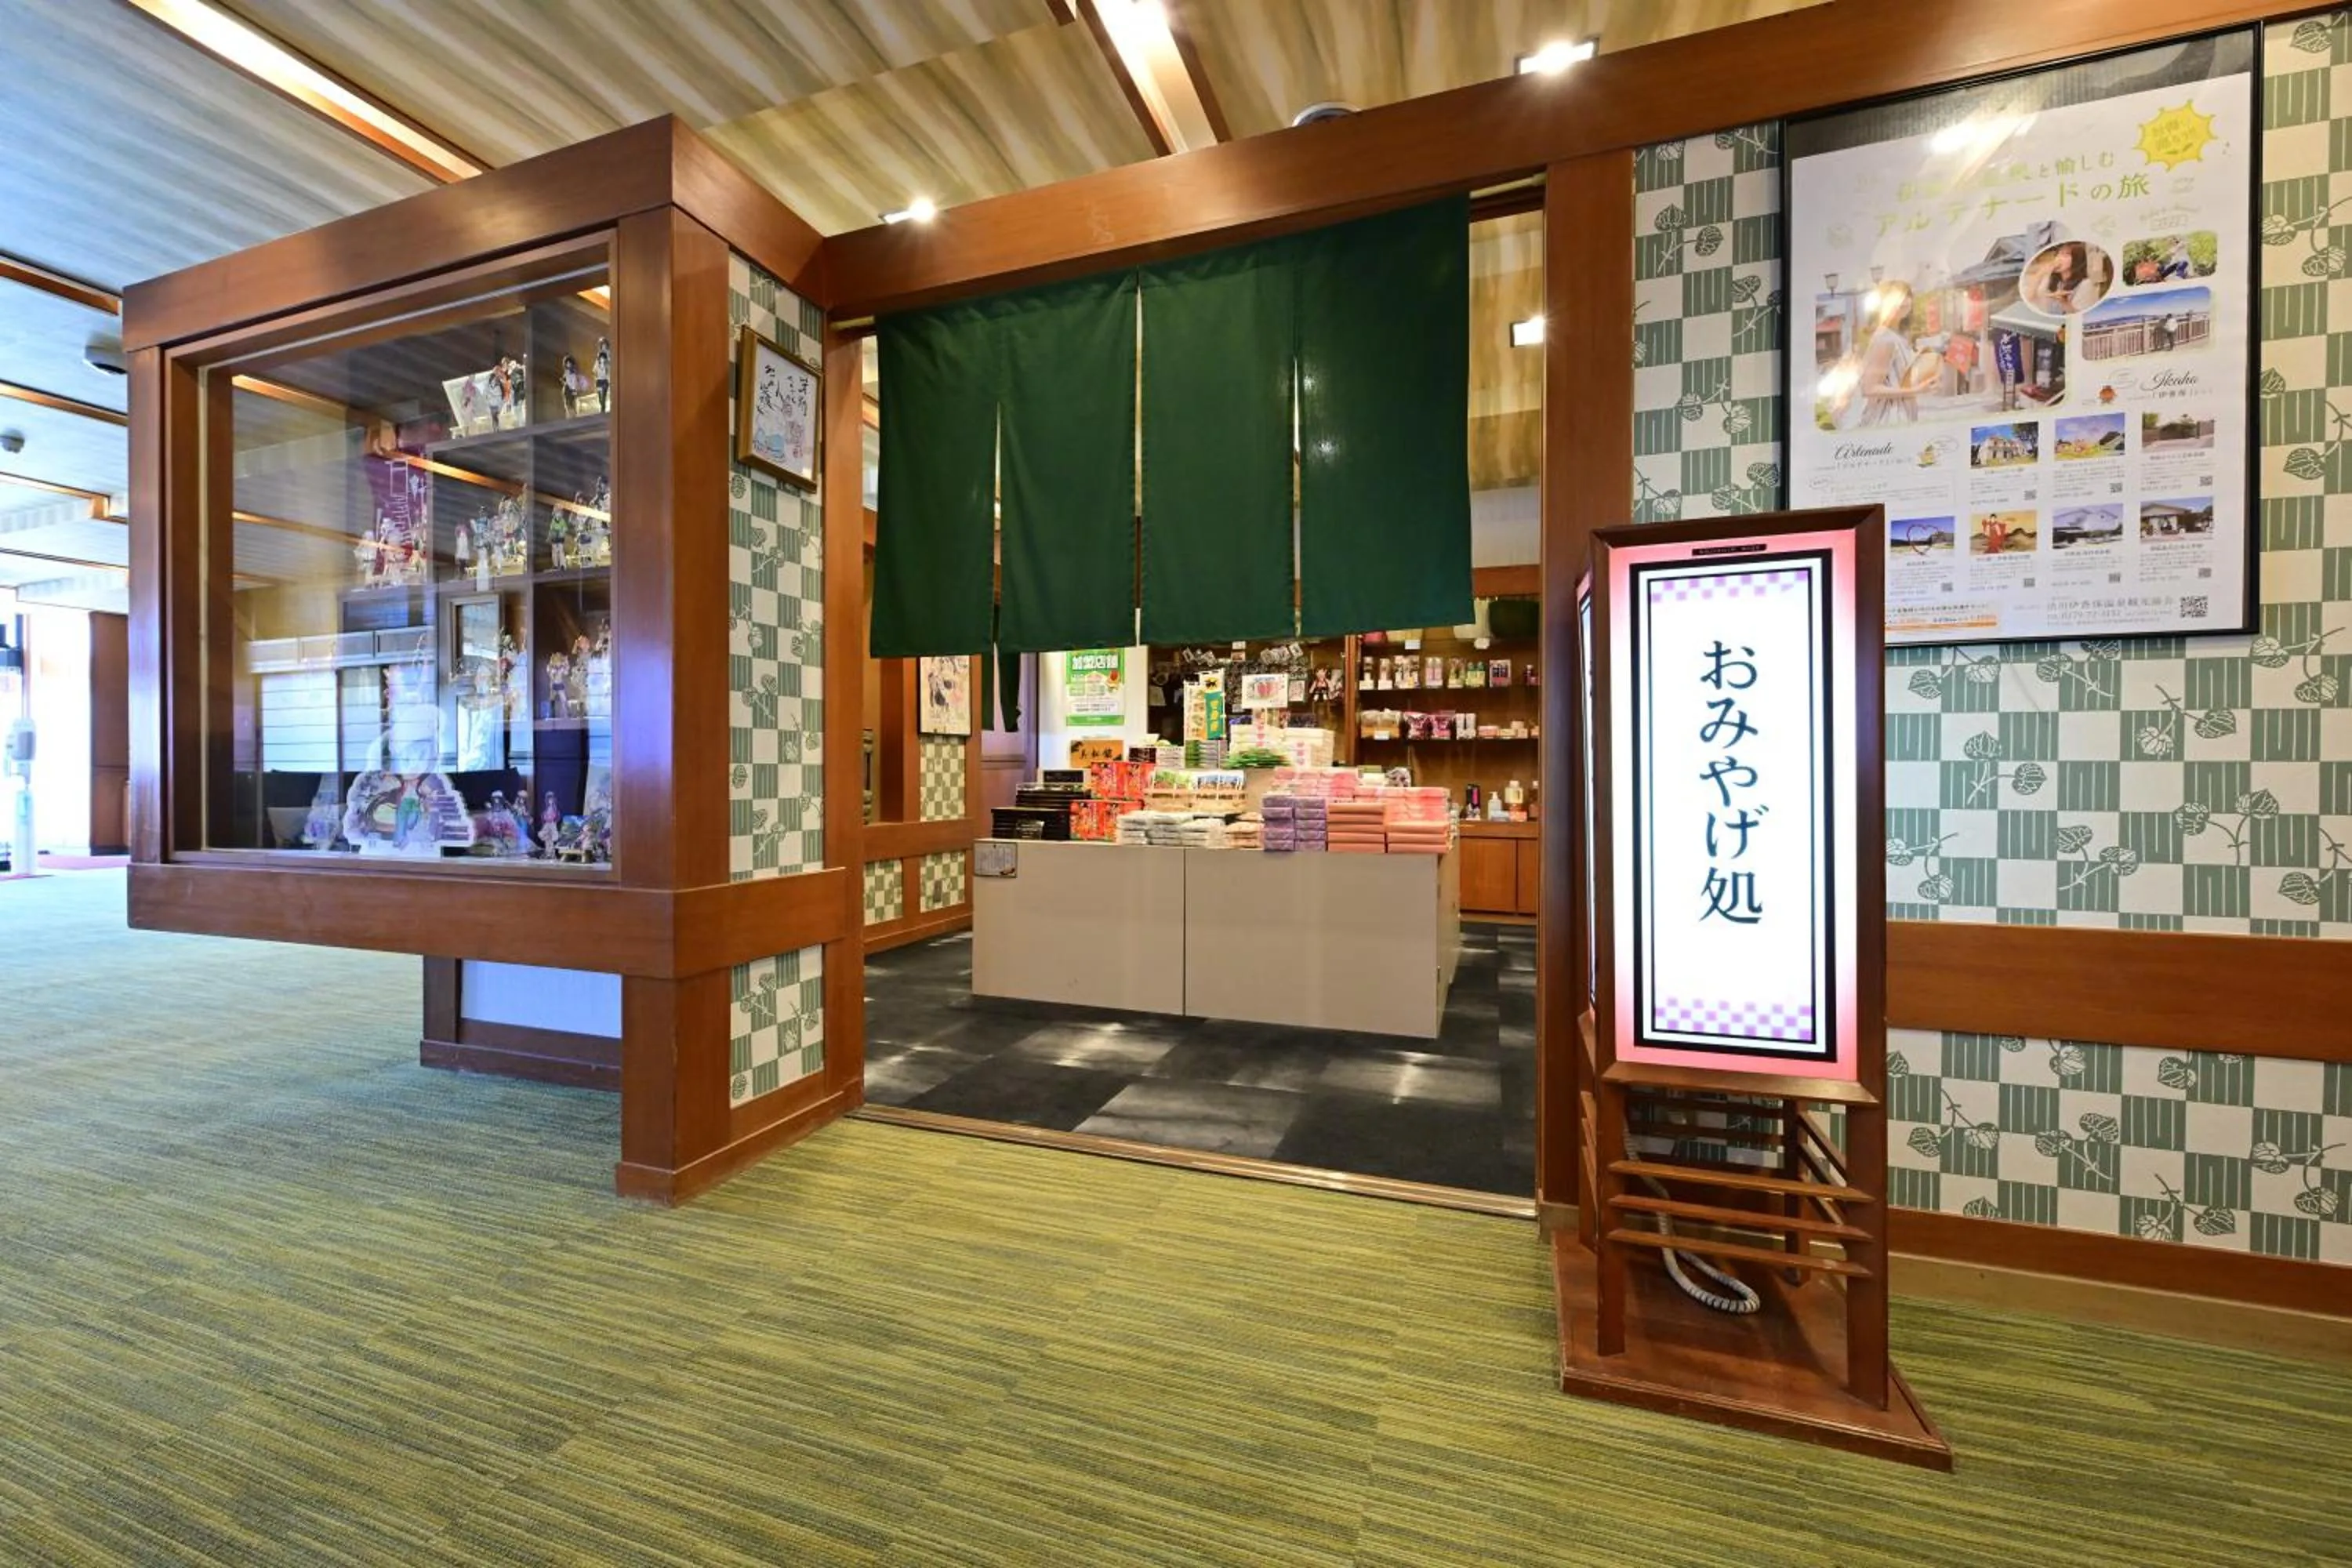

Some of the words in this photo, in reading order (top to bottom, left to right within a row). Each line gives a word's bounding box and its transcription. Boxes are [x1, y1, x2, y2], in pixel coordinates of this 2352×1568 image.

[1875, 172, 2151, 237] アルテナードの旅
[1699, 640, 1769, 924] おみやげ処
